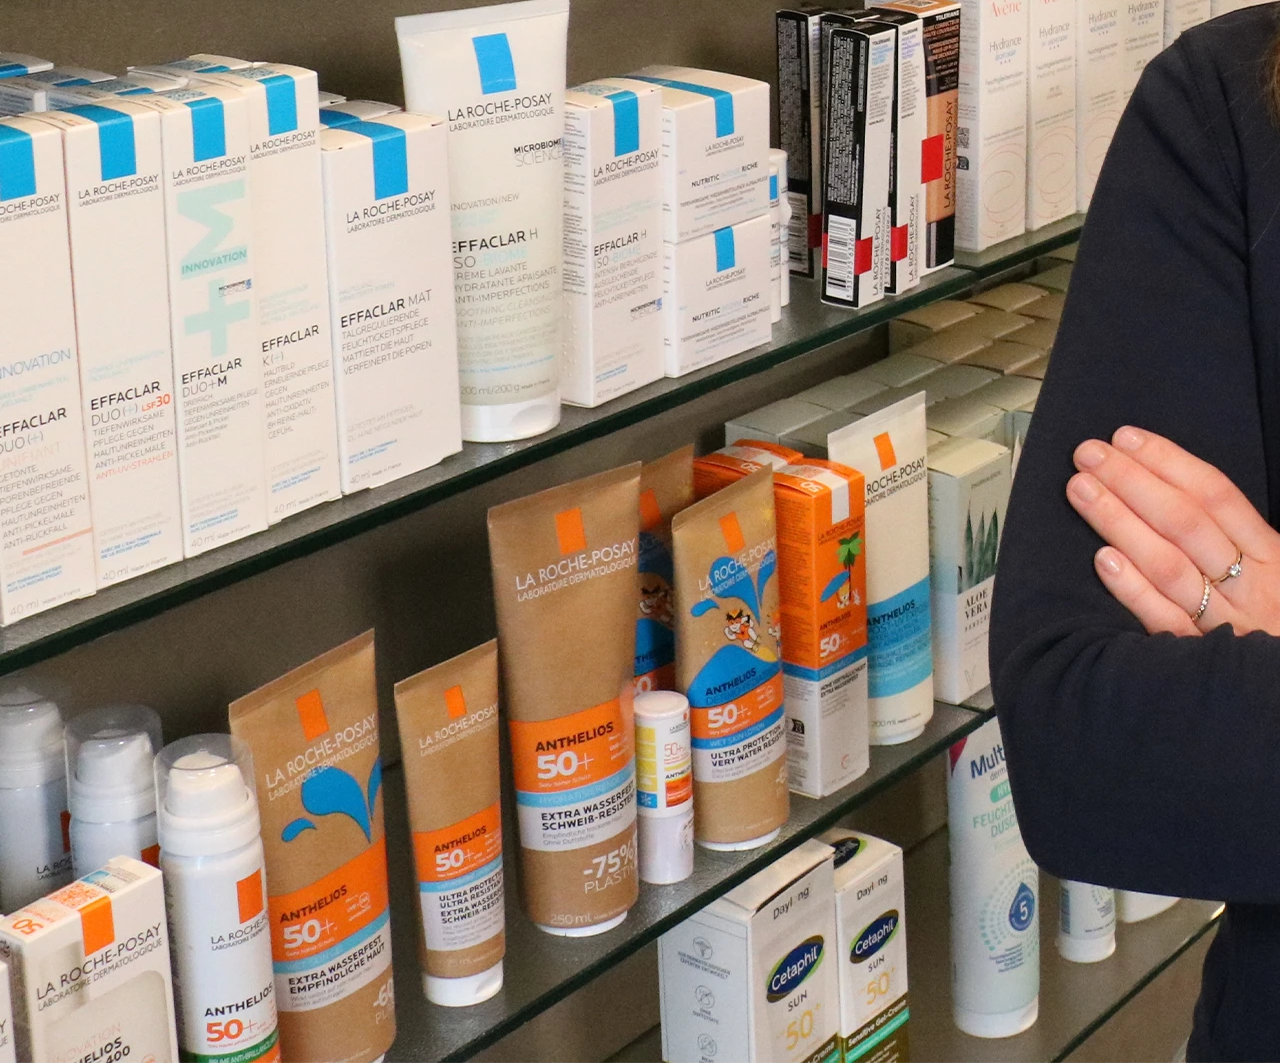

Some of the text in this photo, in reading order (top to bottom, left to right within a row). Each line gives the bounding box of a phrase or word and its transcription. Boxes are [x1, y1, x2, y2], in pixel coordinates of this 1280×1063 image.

[935, 10, 960, 21] TOLERIANE
[990, 0, 1022, 18] Avène
[1088, 9, 1117, 24] Hydrance
[1128, 0, 1159, 15] Hydrance
[989, 36, 1022, 53] Hydrance
[1039, 22, 1070, 39] Hydrance
[448, 92, 552, 122] LA ROCHE-POSAY
[250, 130, 316, 153] LA ROCHE-POSAY
[513, 137, 562, 154] MICROBIOME
[944, 100, 953, 209] LA ROCHE-POSAY
[173, 155, 246, 179] LA ROCHE-POSAY
[593, 149, 659, 177] LA ROCHE-POSAY
[691, 161, 758, 188] NUTRITIC RICHE
[79, 174, 159, 200] LA ROCHE-POSAY
[347, 190, 435, 224] LA ROCHE-POSAY
[530, 228, 539, 240] H
[593, 232, 639, 256] EFFACLAR
[182, 249, 247, 274] INNOVATION
[340, 289, 432, 328] EFFACLAR MAT
[692, 292, 760, 323] NUTRITIC RICHE
[342, 308, 420, 339] TALGREGULIERENDE
[342, 317, 428, 352] FEUCHTIGKEITSPFLEGE
[262, 325, 319, 353] EFFACLAR
[343, 333, 414, 363] MATTIERT DIE HAUT
[344, 339, 432, 375] VERFEINERT DIE POREN
[182, 358, 242, 385] EFFACLAR
[91, 381, 160, 410] EFFACLAR
[91, 393, 170, 427] DUO 30
[92, 410, 164, 436] TIEFENWIRKSAME
[94, 429, 174, 459] HAUTUNREINHEITEN
[95, 441, 166, 469] ANTI-PICKELMALE
[96, 451, 173, 480] ANTI-UV-STRAHLEN
[867, 457, 926, 495] ROCHE-POSAY
[516, 539, 637, 590] LA ROCHE-POSAY
[698, 538, 775, 591] LA ROCHE-POSAY
[964, 587, 988, 610] ALOE
[819, 611, 852, 632] ANTHELIOS
[866, 599, 916, 627] ANTHELIOS
[705, 668, 756, 696] ANTHELIOS
[418, 703, 498, 749] LA ROCHE-POSAY
[708, 703, 749, 730] 50+
[266, 713, 376, 788] LA ROCHE-POSAY
[535, 722, 614, 753] ANTHELIOS
[537, 749, 594, 779] 50+
[710, 749, 736, 761] ULTRA
[712, 744, 759, 768] VERY WATER
[541, 806, 571, 822] EXTRA
[434, 825, 487, 853] ANTHELIOS
[436, 848, 475, 872] 50+
[280, 884, 348, 924] ANTHELIOS
[439, 891, 464, 901] ULTRA
[440, 898, 465, 909] ULTRA
[441, 906, 464, 917] EXTRA
[1019, 903, 1028, 921] 5
[211, 933, 225, 945] LA
[283, 919, 334, 949] 50+
[855, 920, 894, 955] Cetaphil
[36, 922, 162, 1000] LA ROCHE-POSAY
[289, 935, 382, 986] EXTRA WASSERFEST
[290, 942, 385, 995] EMPFINDLICHE HAUT
[771, 946, 818, 991] Cetaphil
[868, 955, 885, 972] SUN
[205, 981, 274, 1018] ANTHELIOS
[787, 990, 808, 1012] SUN
